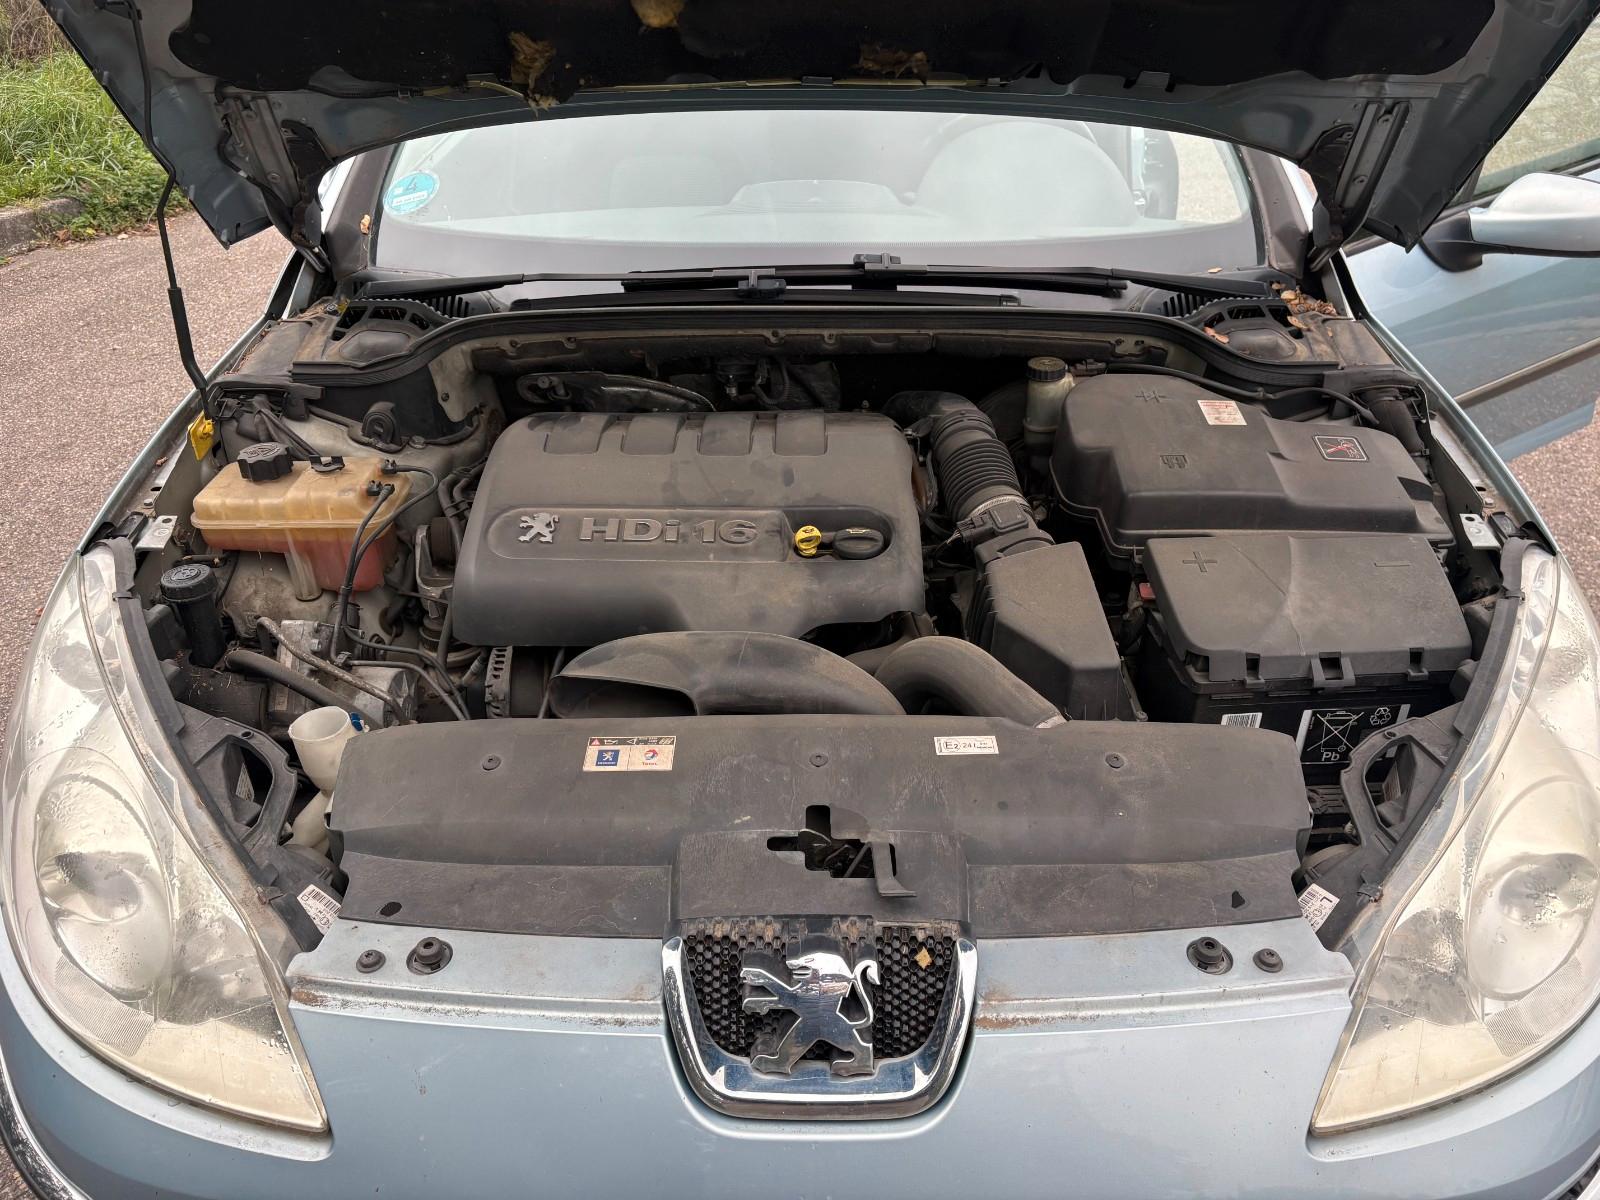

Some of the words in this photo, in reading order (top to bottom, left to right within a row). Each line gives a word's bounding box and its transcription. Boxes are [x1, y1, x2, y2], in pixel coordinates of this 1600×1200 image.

[580, 517, 681, 542] HDi
[697, 519, 758, 544] 16
[1321, 751, 1340, 761] Pb
